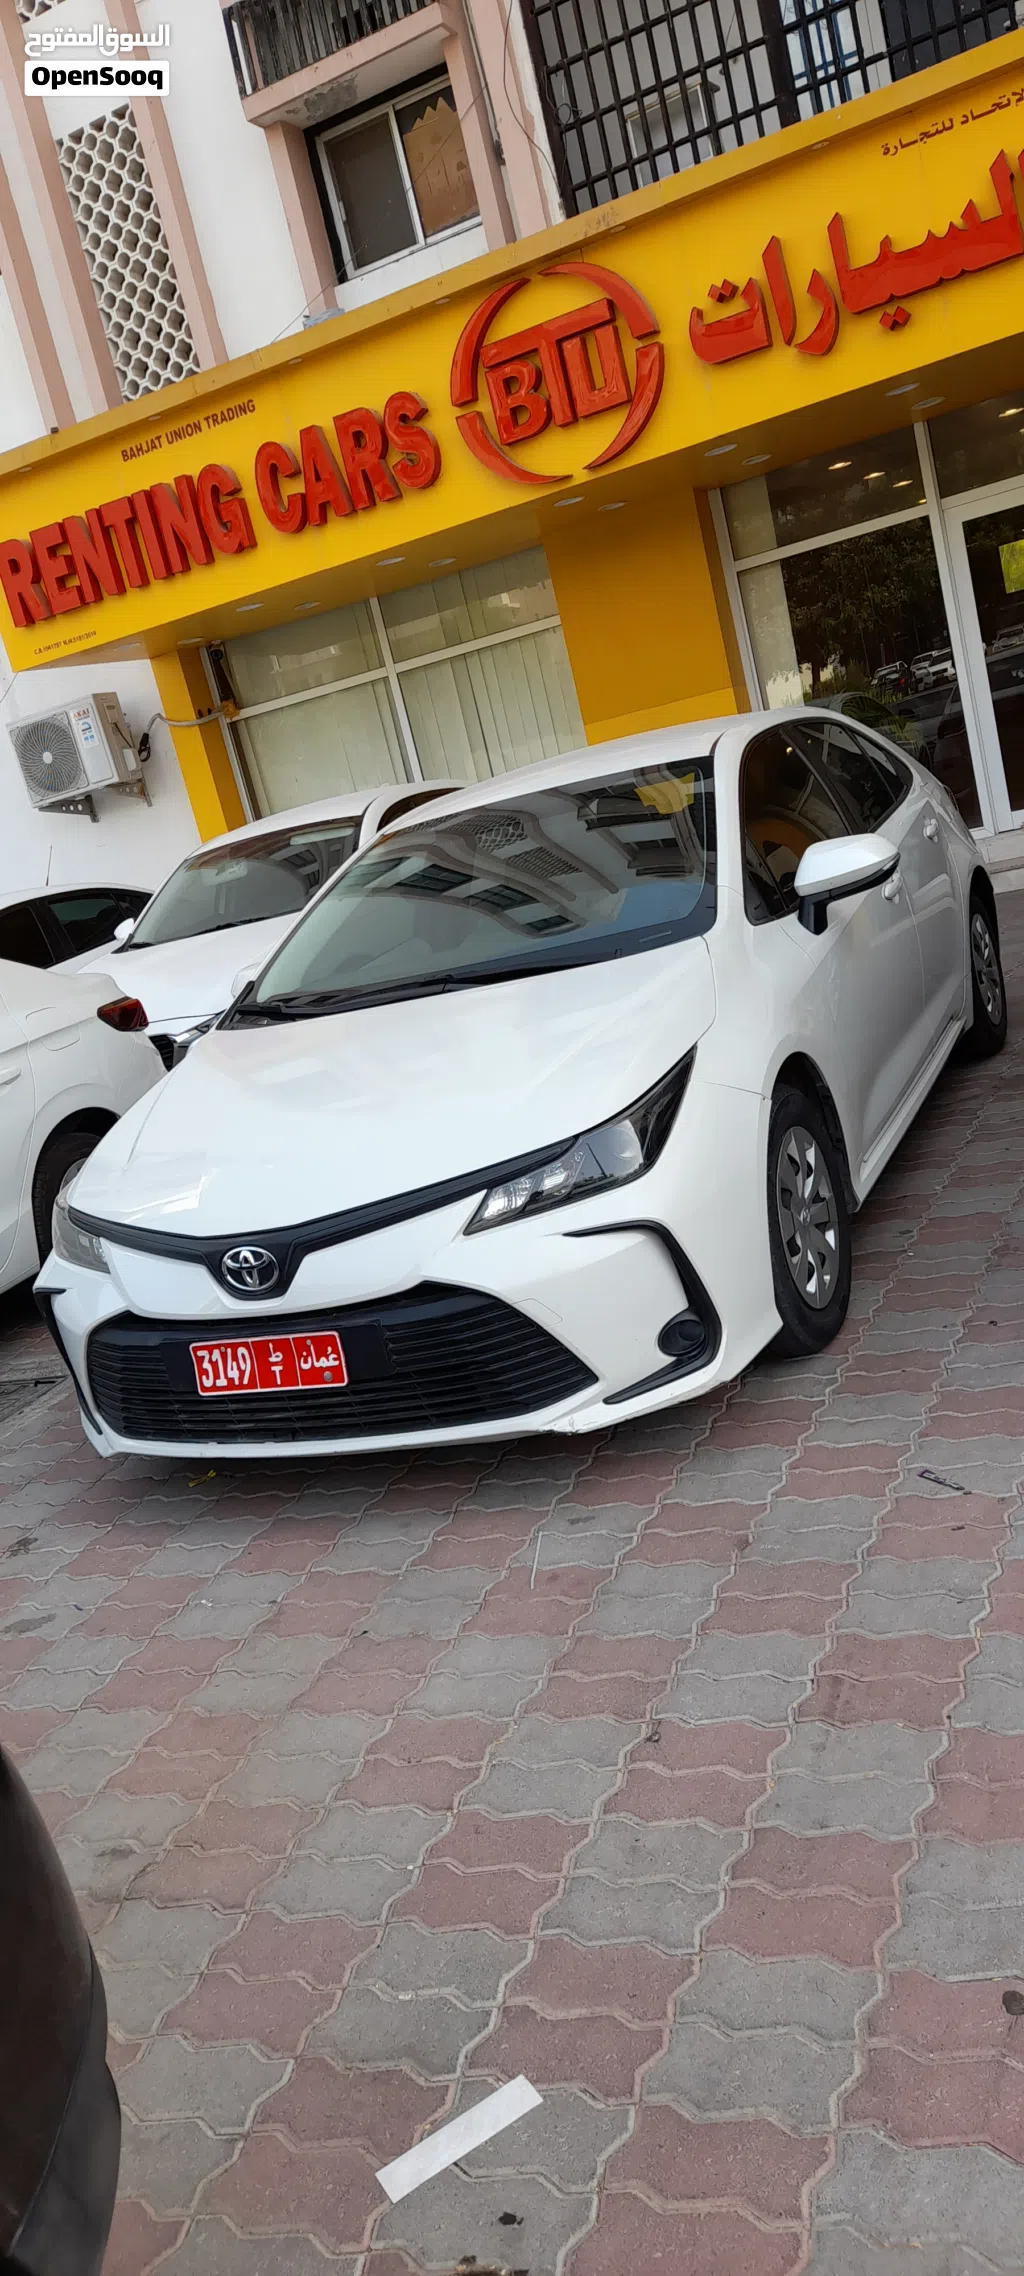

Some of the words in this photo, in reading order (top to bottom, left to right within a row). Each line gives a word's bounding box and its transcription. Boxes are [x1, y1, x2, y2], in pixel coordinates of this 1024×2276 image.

[881, 118, 954, 156] للتجارة
[689, 149, 1024, 364] لسيارات
[480, 297, 632, 446] BTU
[121, 435, 163, 463] BAHJAT
[165, 420, 202, 445] UNION
[203, 399, 256, 430] TRADING
[0, 463, 258, 628] RENTING
[255, 391, 441, 533] CARS
[197, 1347, 250, 1388] 3149
